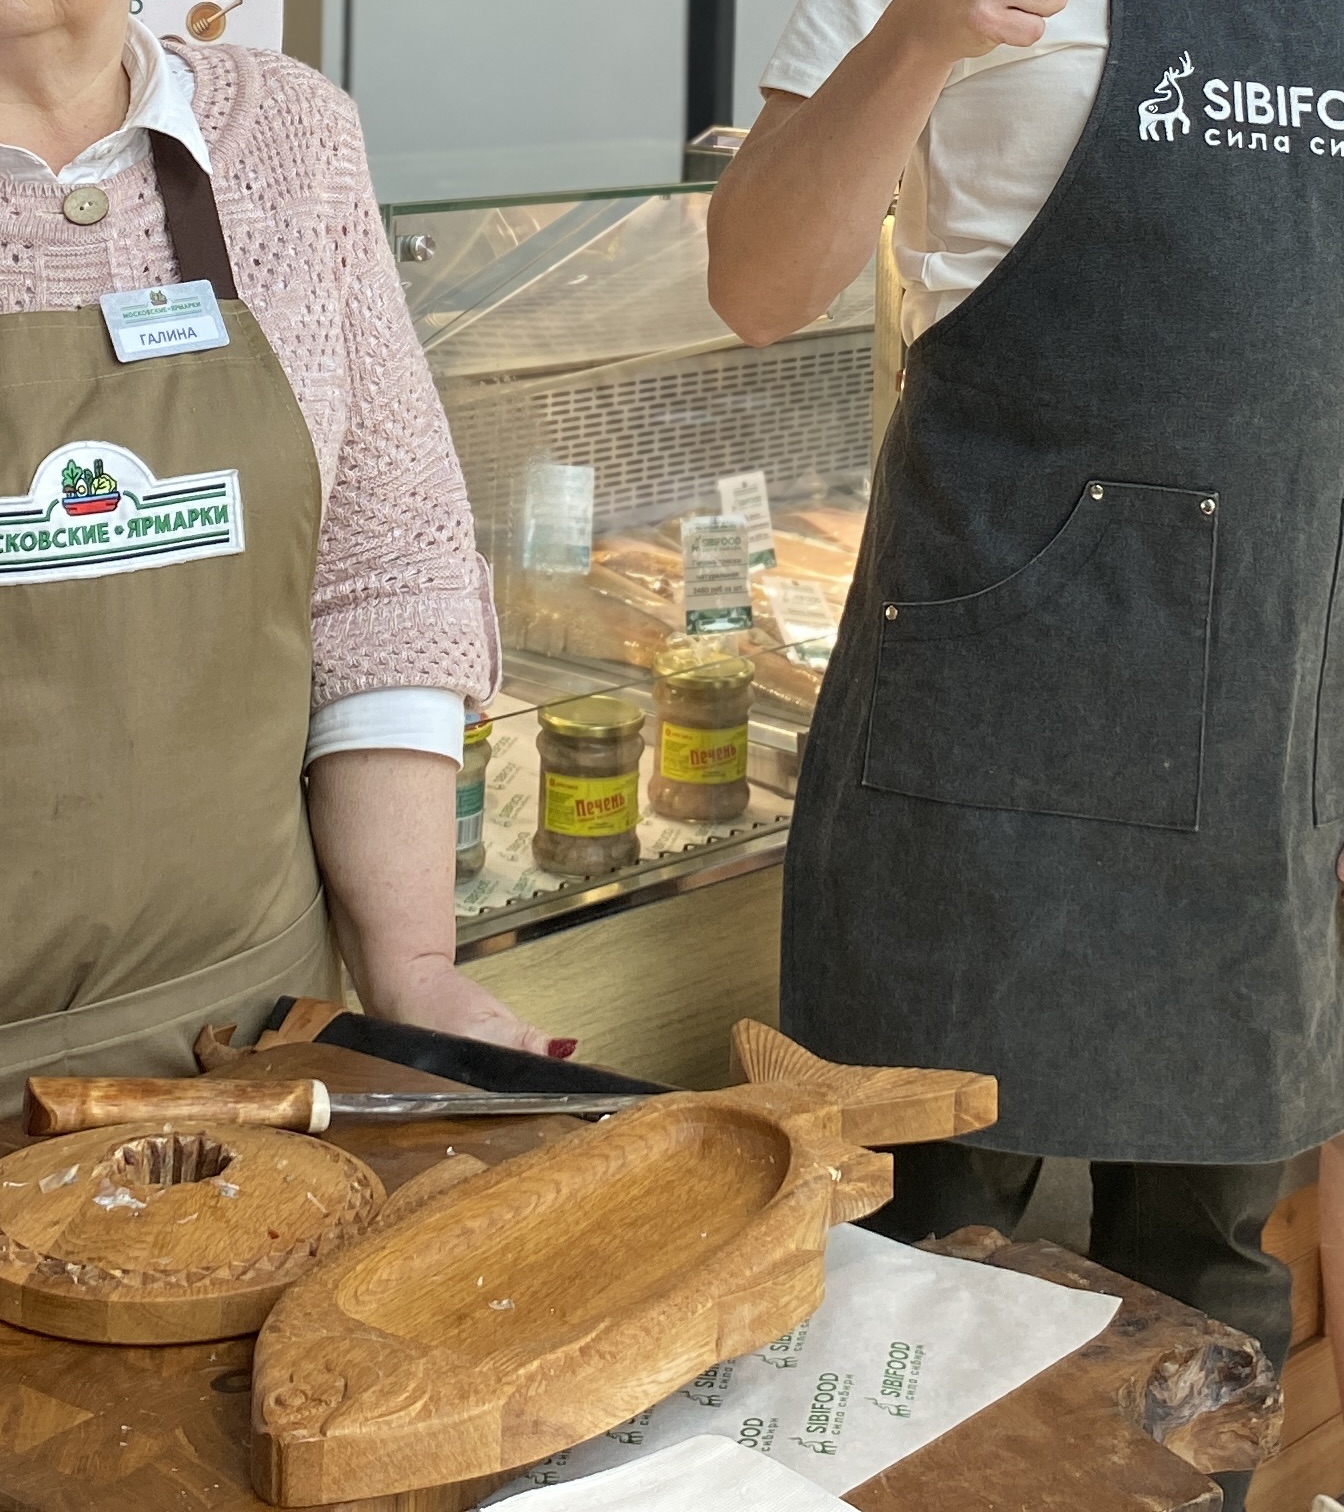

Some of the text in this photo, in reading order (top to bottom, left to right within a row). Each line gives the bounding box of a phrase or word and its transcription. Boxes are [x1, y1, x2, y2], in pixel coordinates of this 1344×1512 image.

[1204, 128, 1290, 154] сила
[139, 326, 197, 346] ГАЛИНА
[126, 504, 230, 538] ЯРМАРКИ
[690, 743, 737, 766] Печень
[575, 792, 626, 817] Печень
[880, 1341, 911, 1398] SIBIFOOD
[806, 1373, 840, 1434] SIBIFOOD
